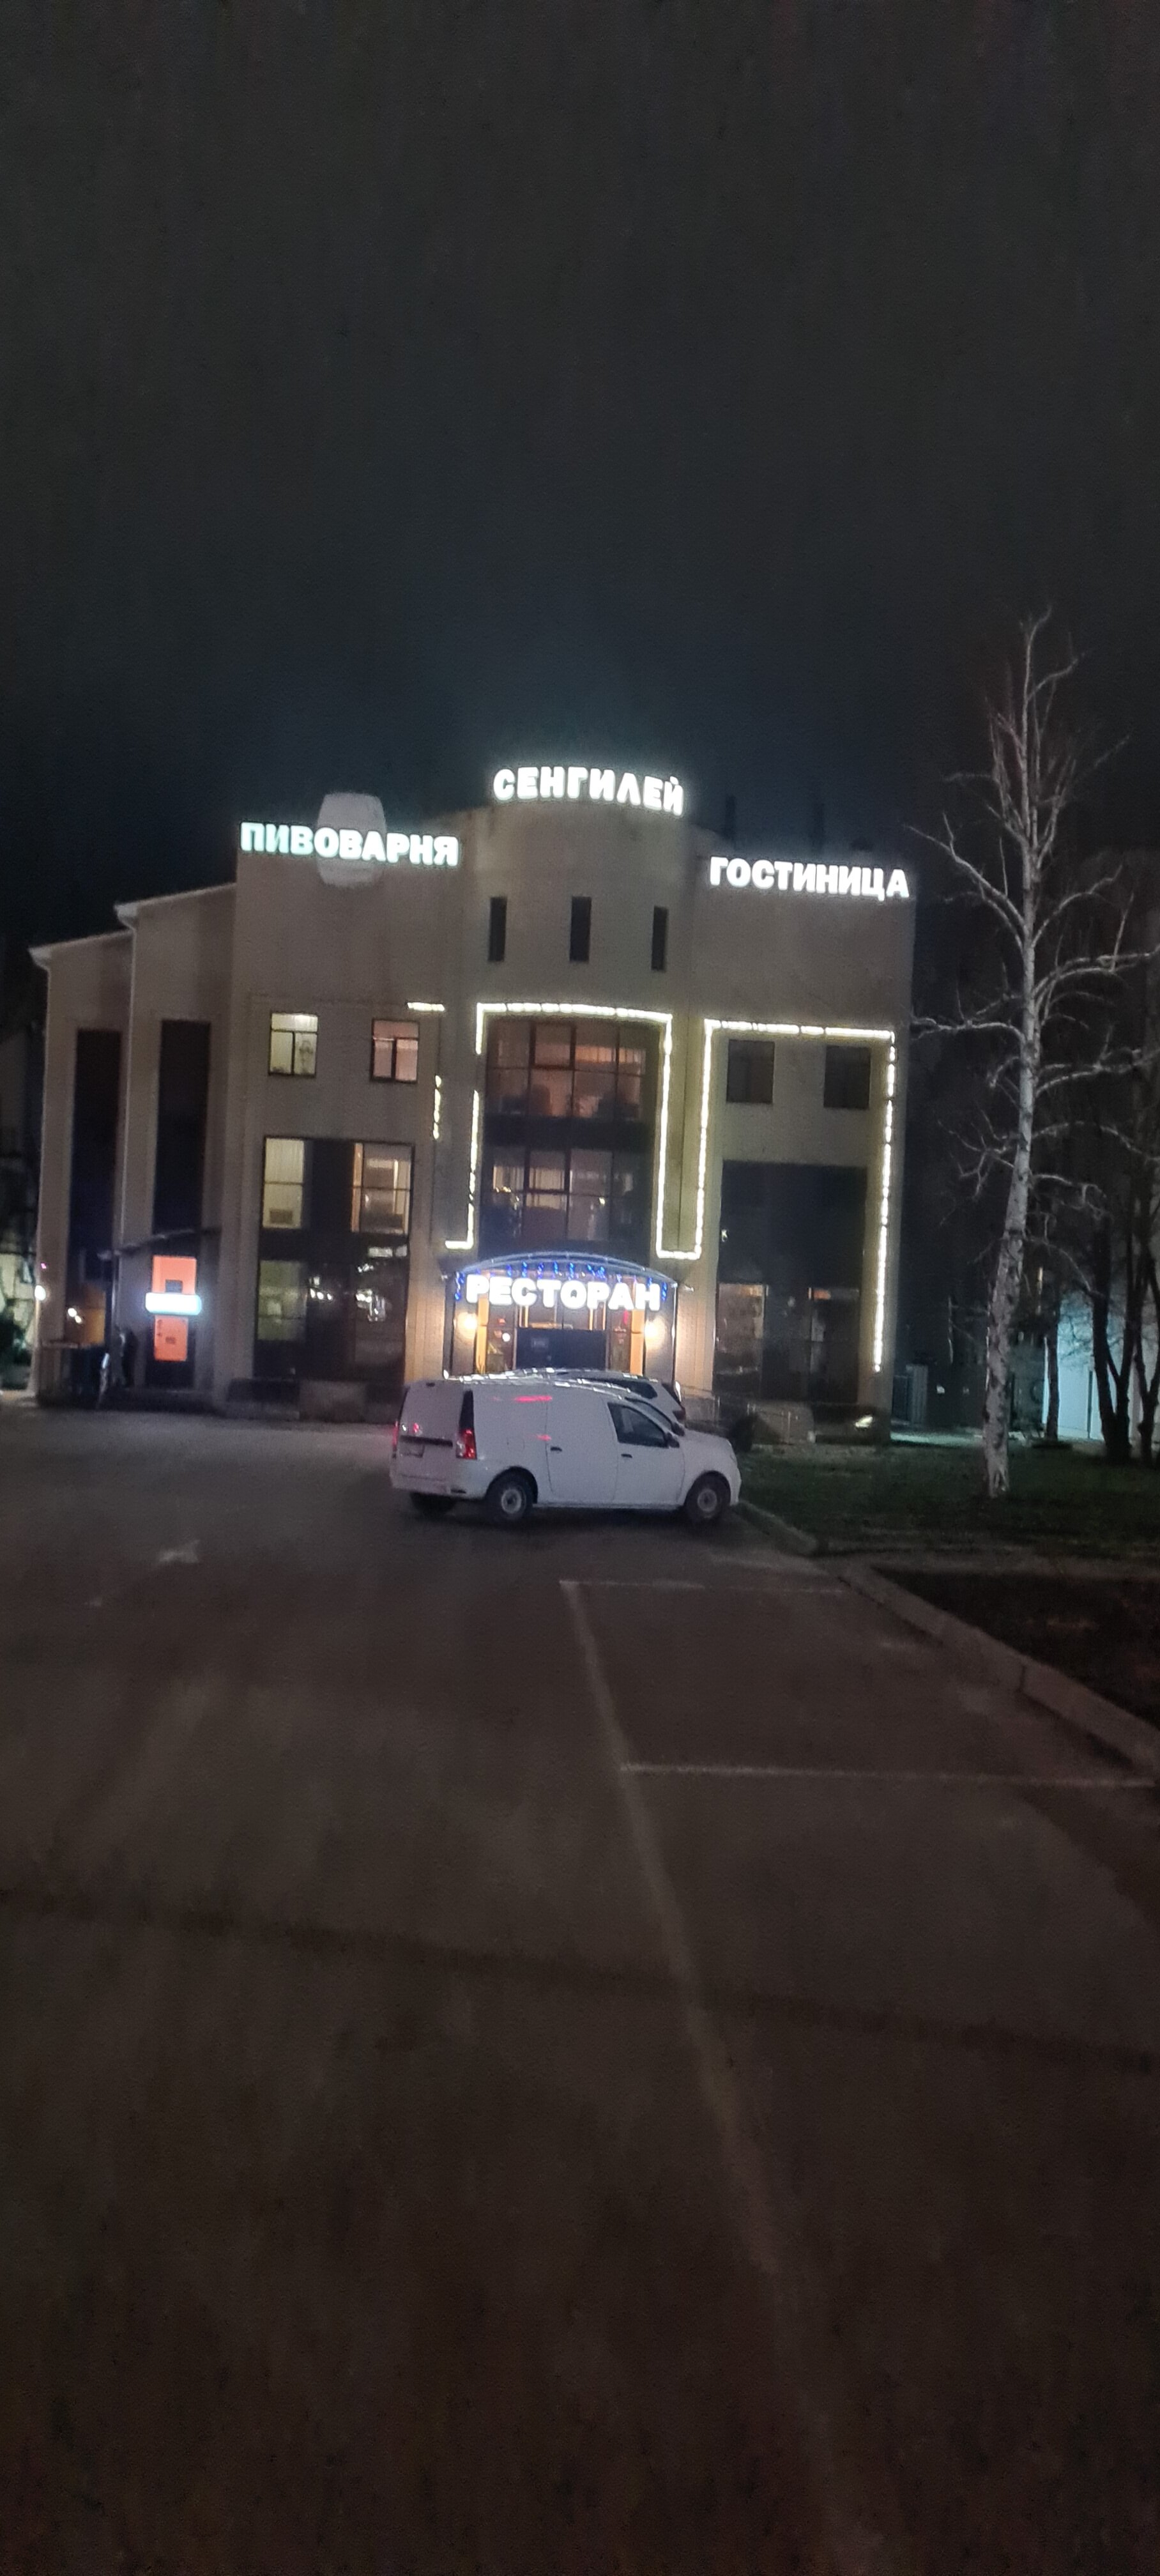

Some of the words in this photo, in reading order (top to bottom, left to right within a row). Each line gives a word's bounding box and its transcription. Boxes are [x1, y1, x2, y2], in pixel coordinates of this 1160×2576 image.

[494, 767, 683, 816] СЕНГИЛЕЙ
[241, 822, 458, 866] ПИВОВАРНЯ
[710, 857, 909, 901] ГОСТИНИЦА
[466, 1274, 660, 1311] РЕСТОРАН
